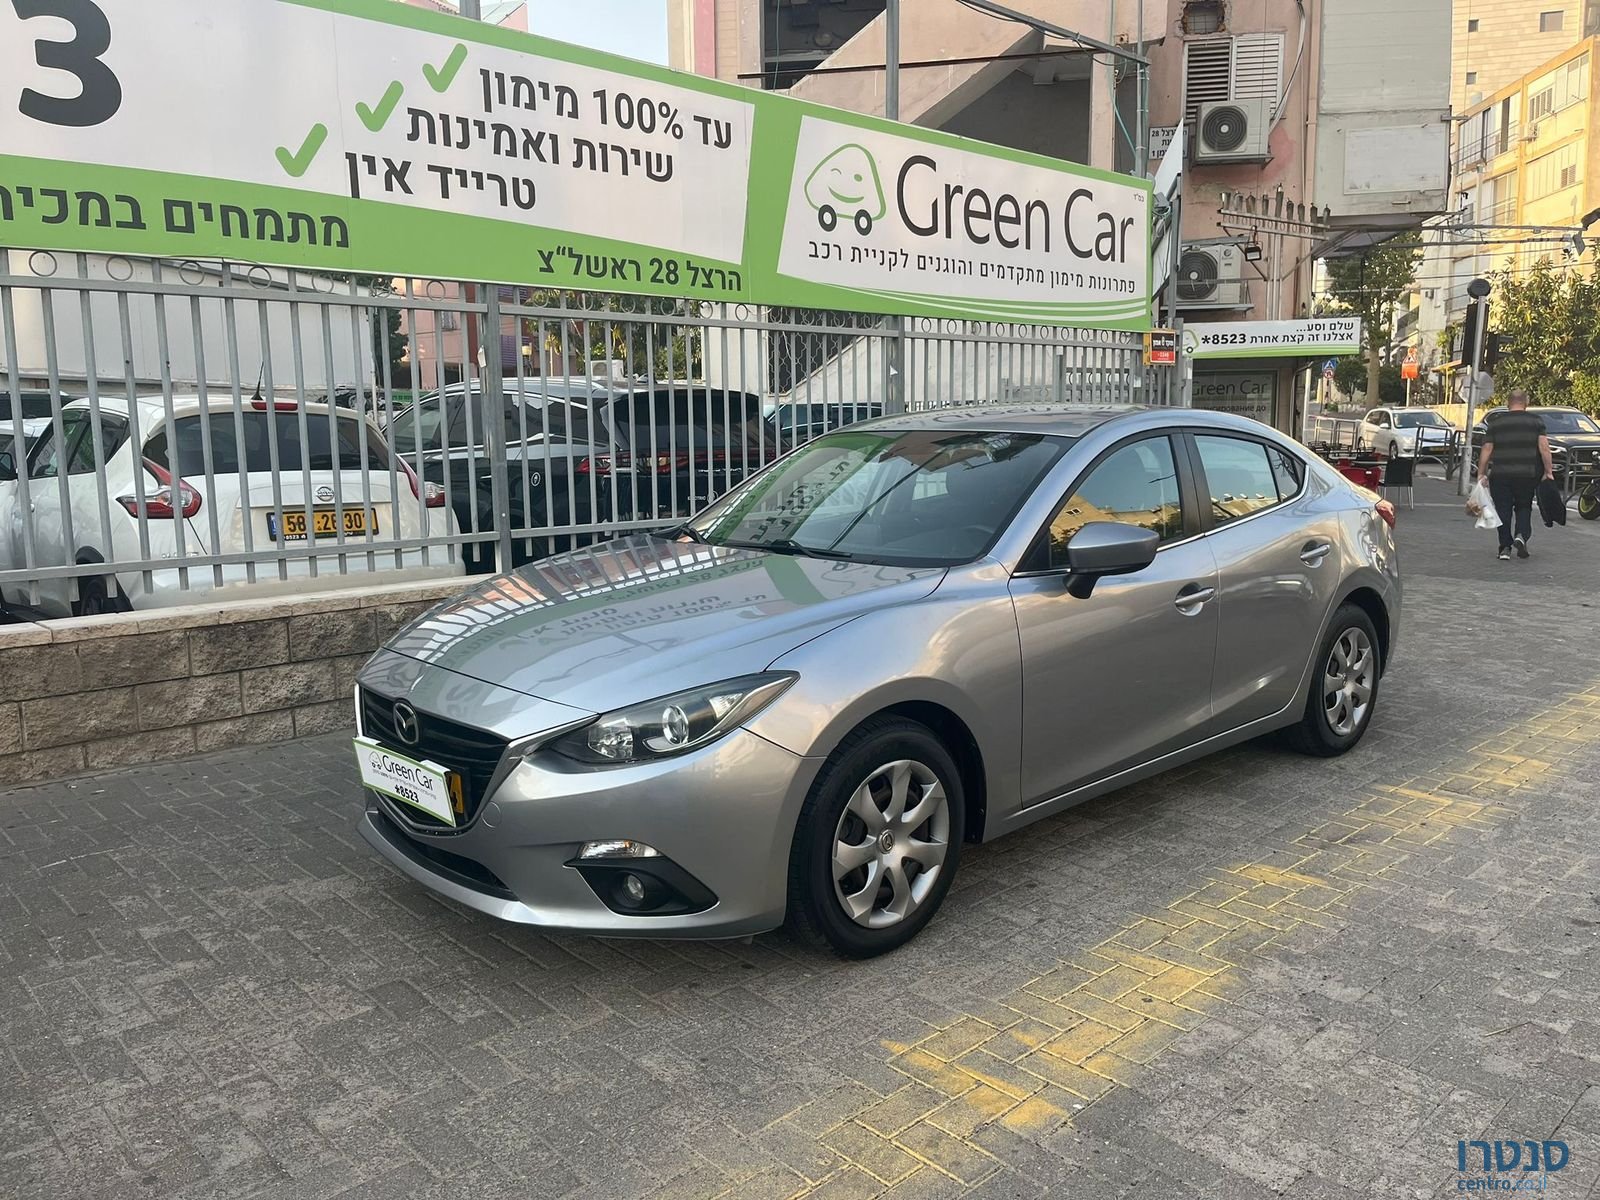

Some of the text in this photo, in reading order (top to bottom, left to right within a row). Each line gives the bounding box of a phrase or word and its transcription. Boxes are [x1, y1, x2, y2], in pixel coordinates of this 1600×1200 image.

[11, 0, 122, 127] 3
[479, 68, 732, 149] עד 100% מימון
[406, 107, 673, 183] שירות ואמינות
[344, 151, 536, 210] טרייד אין
[163, 198, 349, 249] מתמחים
[896, 155, 1134, 263] Green Car
[649, 257, 679, 285] 28
[686, 260, 742, 292] הרצל
[808, 241, 1135, 293] פתרונות מימון מתקדמים והוגנים לקניית רכב
[1250, 335, 1279, 344] אחרת
[1282, 334, 1305, 345] קצת
[1308, 333, 1319, 342] זה
[1323, 330, 1353, 341] אצלנו
[1329, 321, 1354, 331] שלם
[1239, 379, 1267, 395] Car
[382, 755, 415, 783] Green
[416, 768, 433, 791] Car
